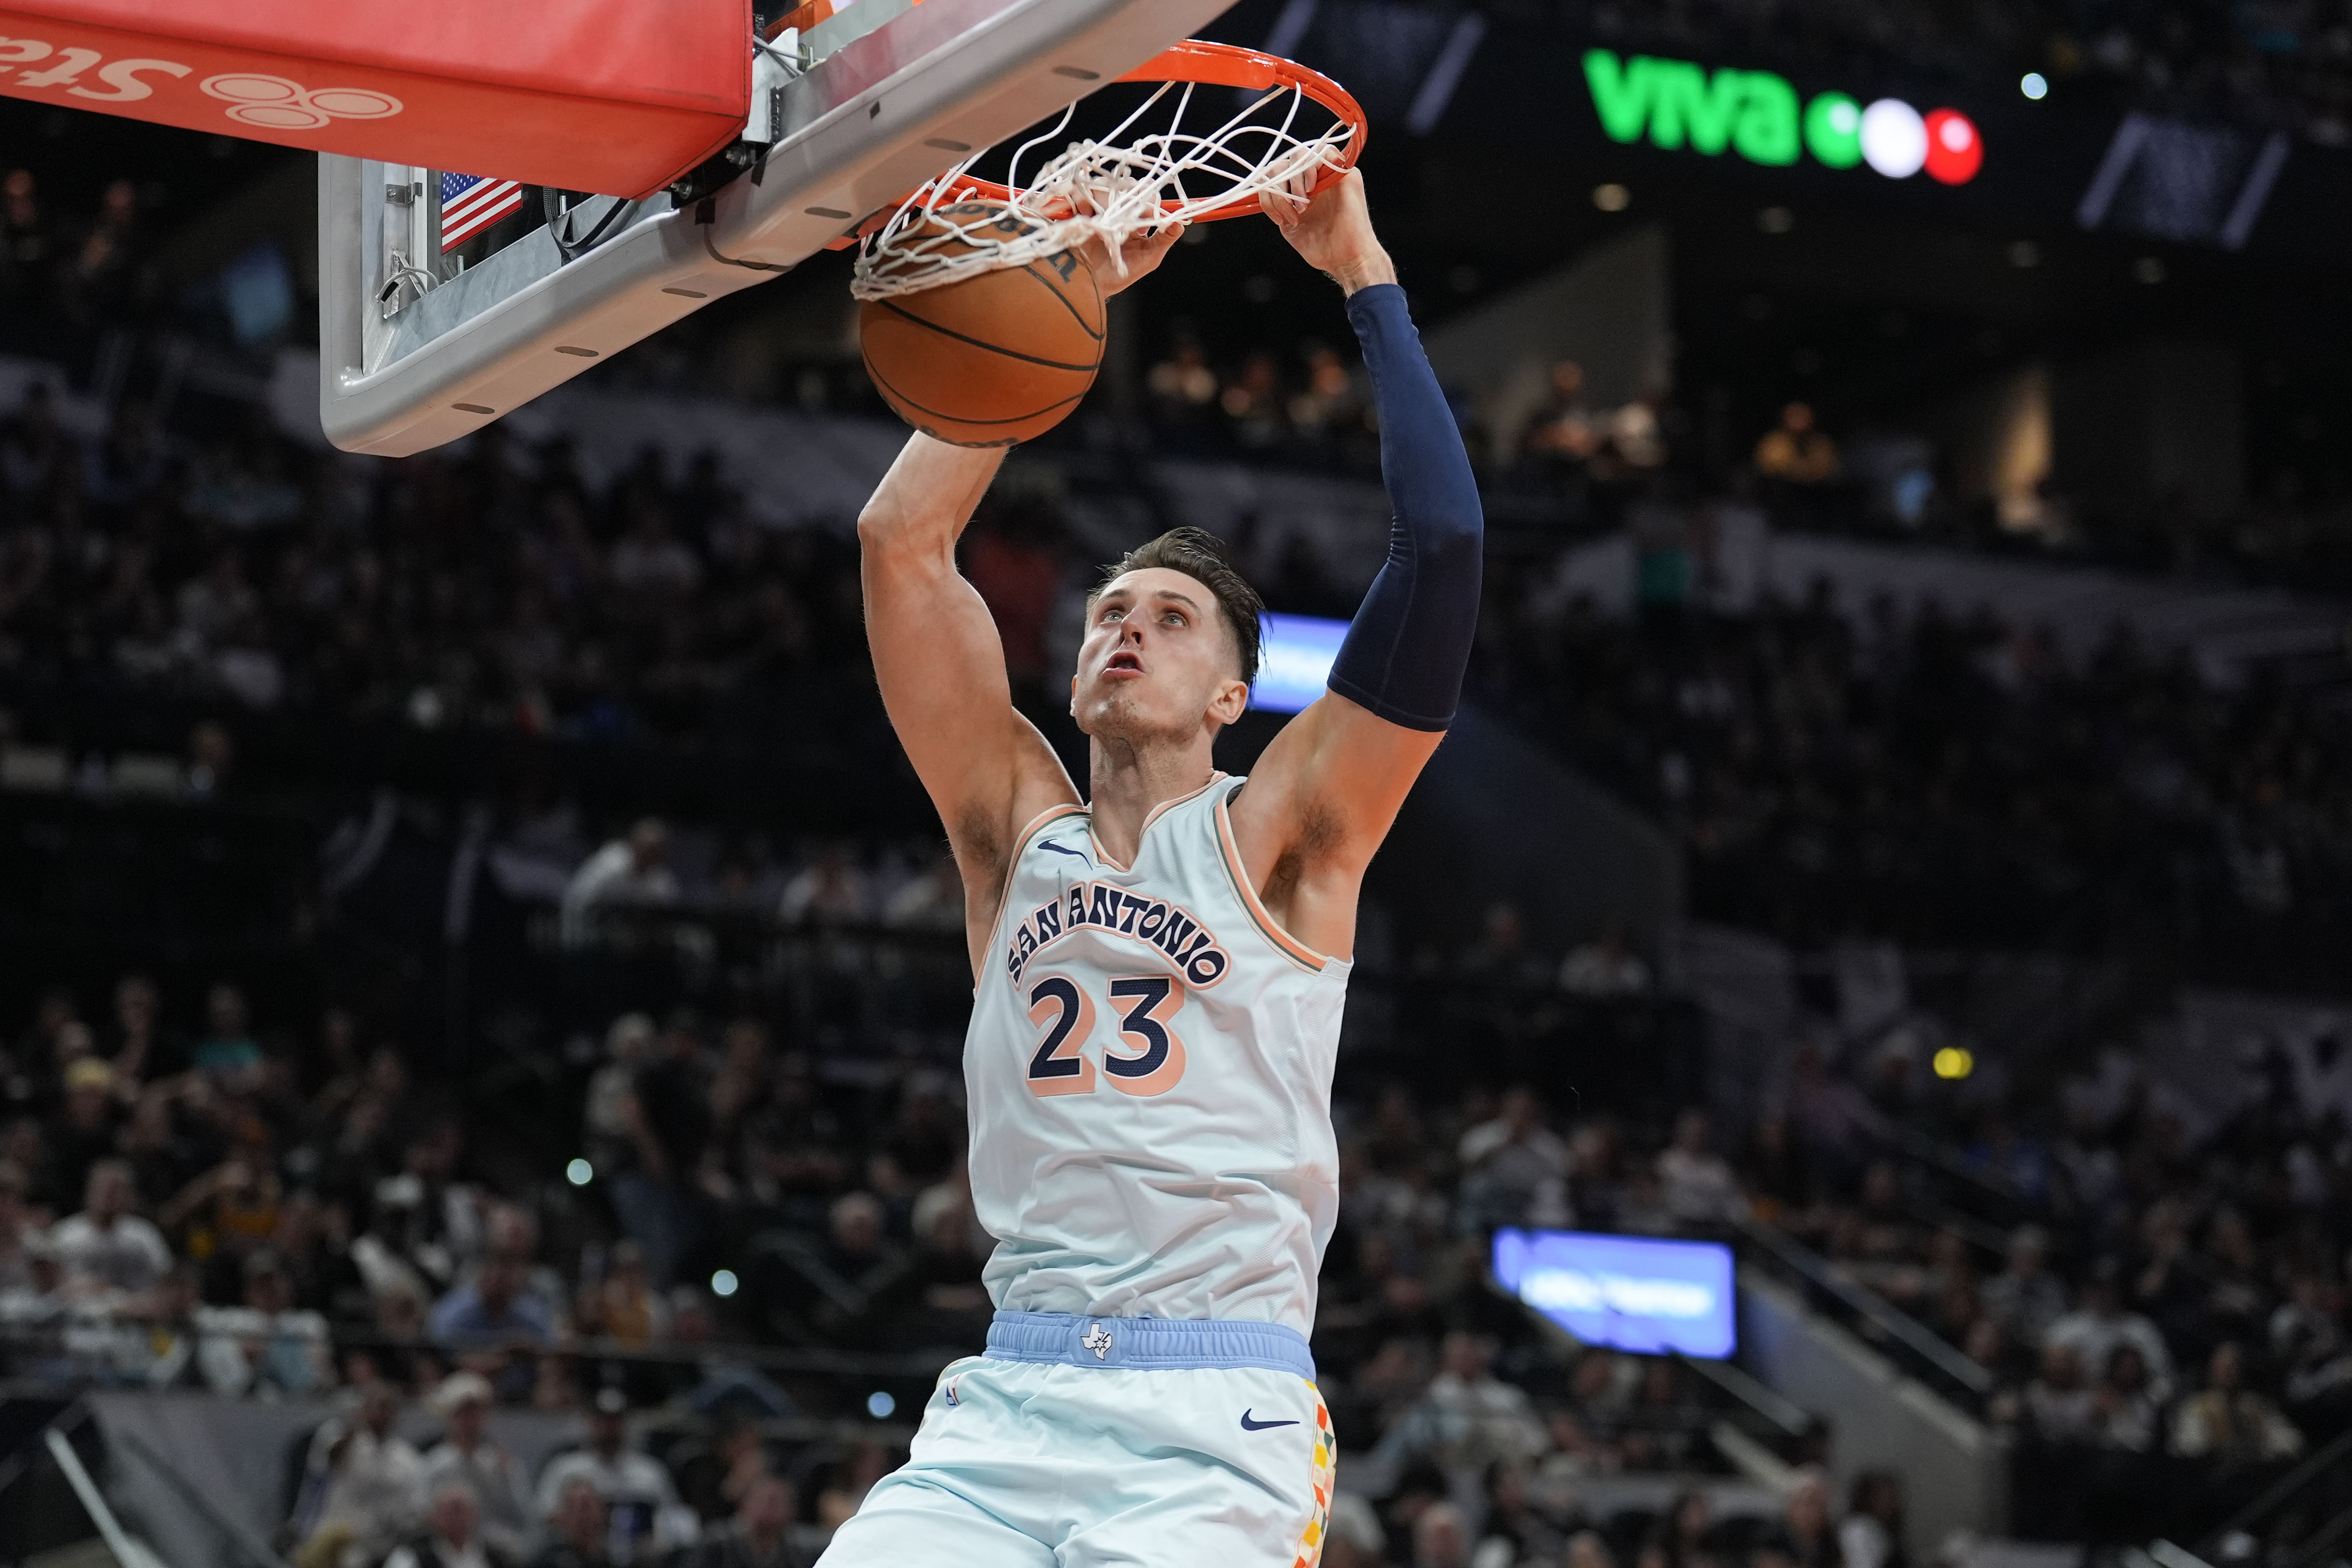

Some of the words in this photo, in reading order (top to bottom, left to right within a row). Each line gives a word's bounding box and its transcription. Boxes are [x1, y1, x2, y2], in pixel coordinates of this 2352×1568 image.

[1007, 897, 1062, 990] SAN
[1065, 881, 1231, 990] ANTONIO
[1026, 974, 1186, 1097] 23
